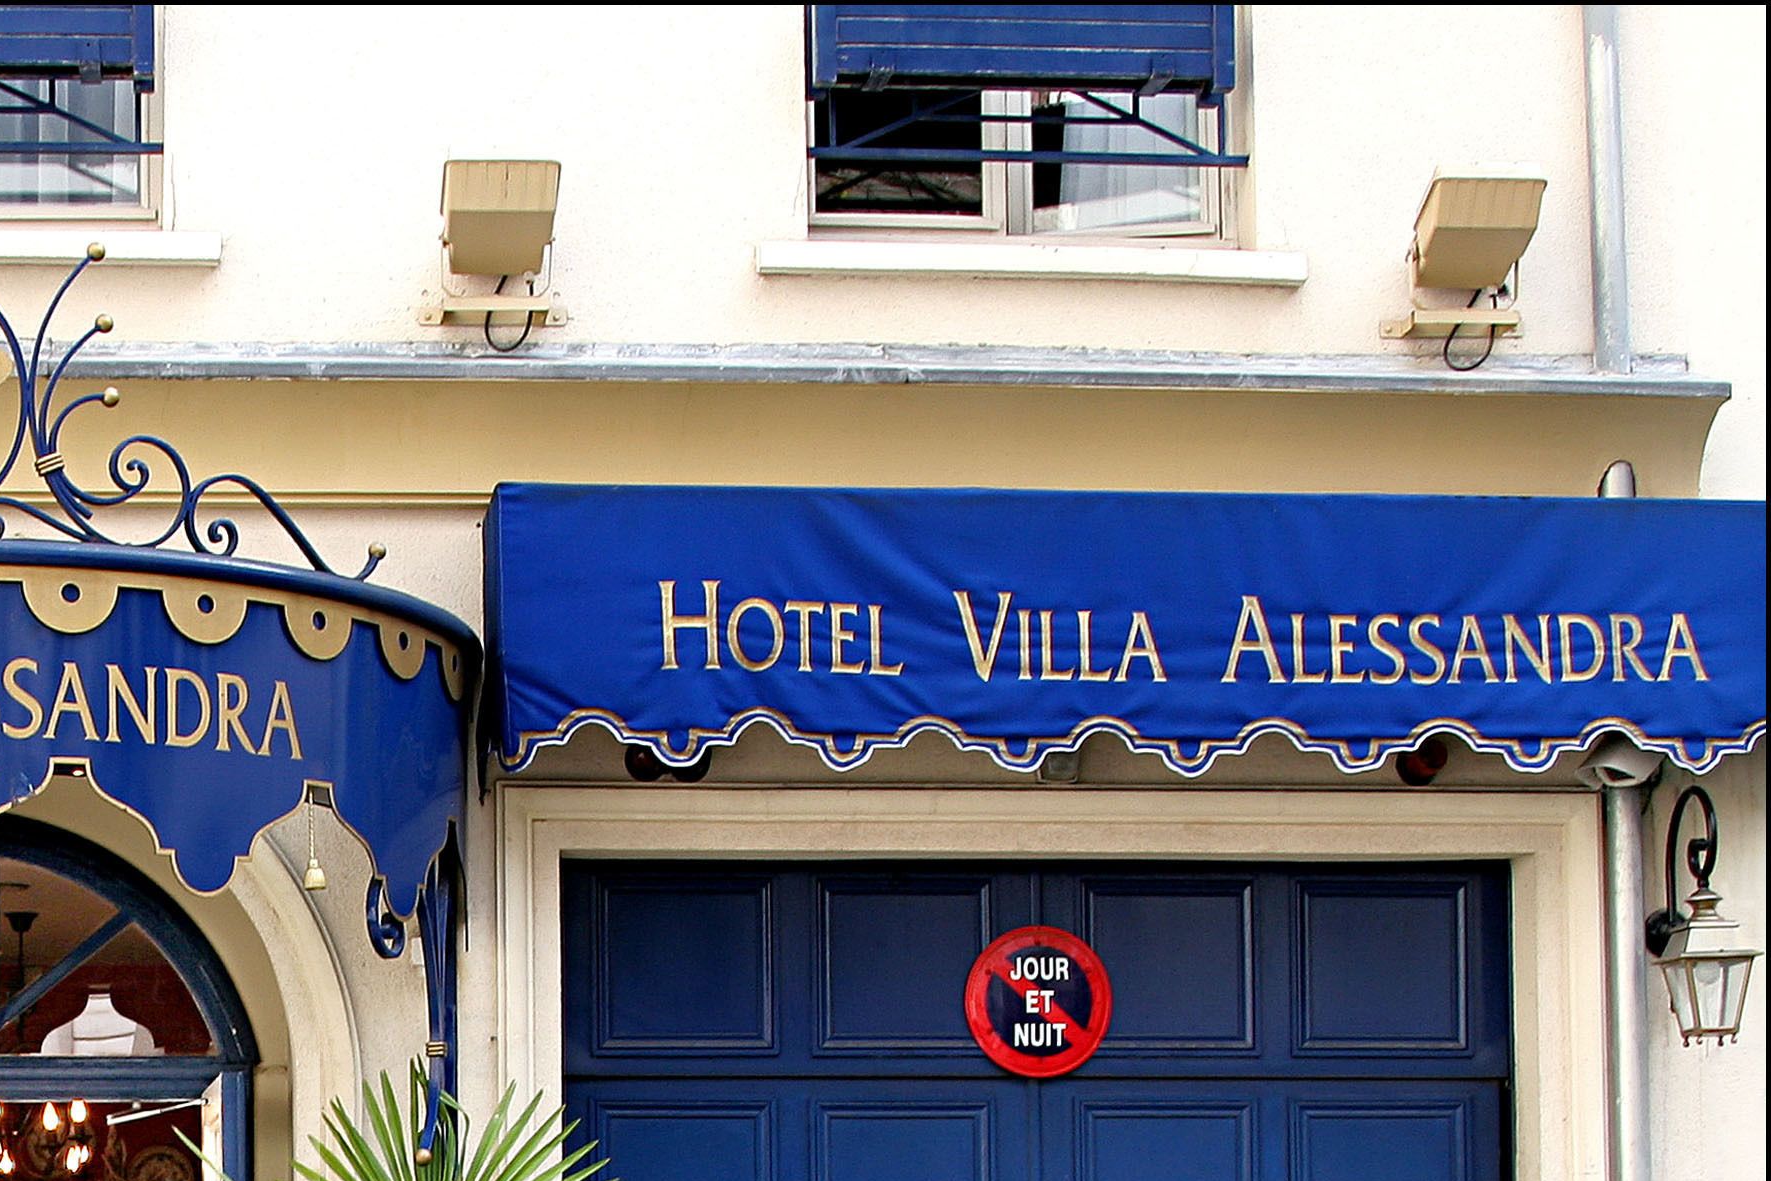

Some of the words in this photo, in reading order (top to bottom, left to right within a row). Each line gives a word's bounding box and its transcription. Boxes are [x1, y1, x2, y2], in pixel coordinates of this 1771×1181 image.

[658, 580, 904, 676] HOTEL
[952, 590, 1168, 683] VILLA
[1220, 595, 1709, 685] ALESSANDRA
[1009, 956, 1069, 981] JOUR
[1025, 990, 1055, 1014] ET
[1014, 1023, 1066, 1047] NUIT
